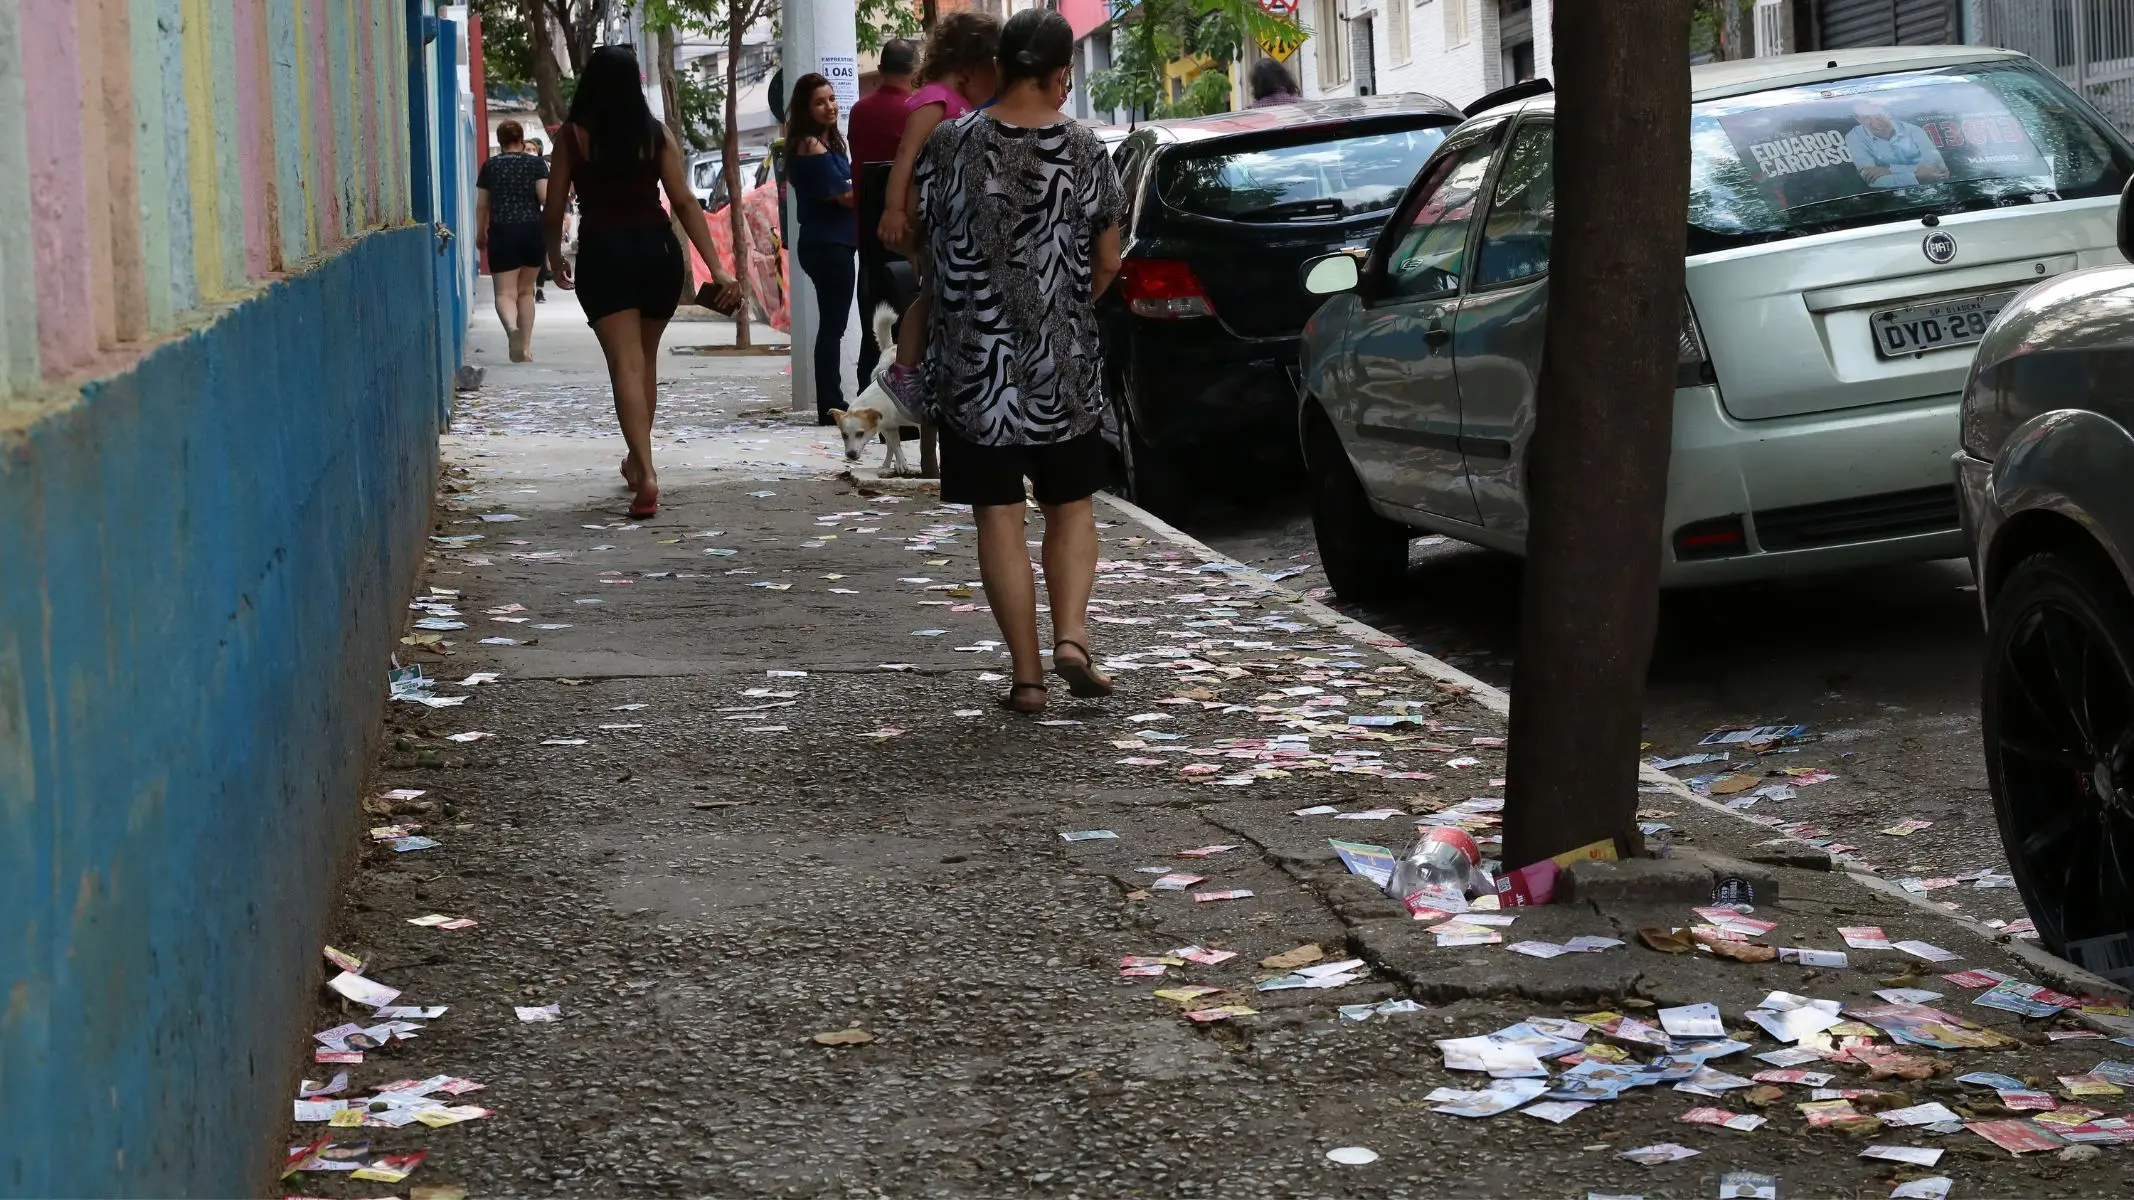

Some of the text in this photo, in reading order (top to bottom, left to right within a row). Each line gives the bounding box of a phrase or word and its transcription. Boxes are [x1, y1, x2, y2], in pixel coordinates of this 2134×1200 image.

[1750, 129, 1845, 162] EDUARDO
[1760, 145, 1853, 178] CARDOSO
[1930, 241, 1951, 253] FIAT
